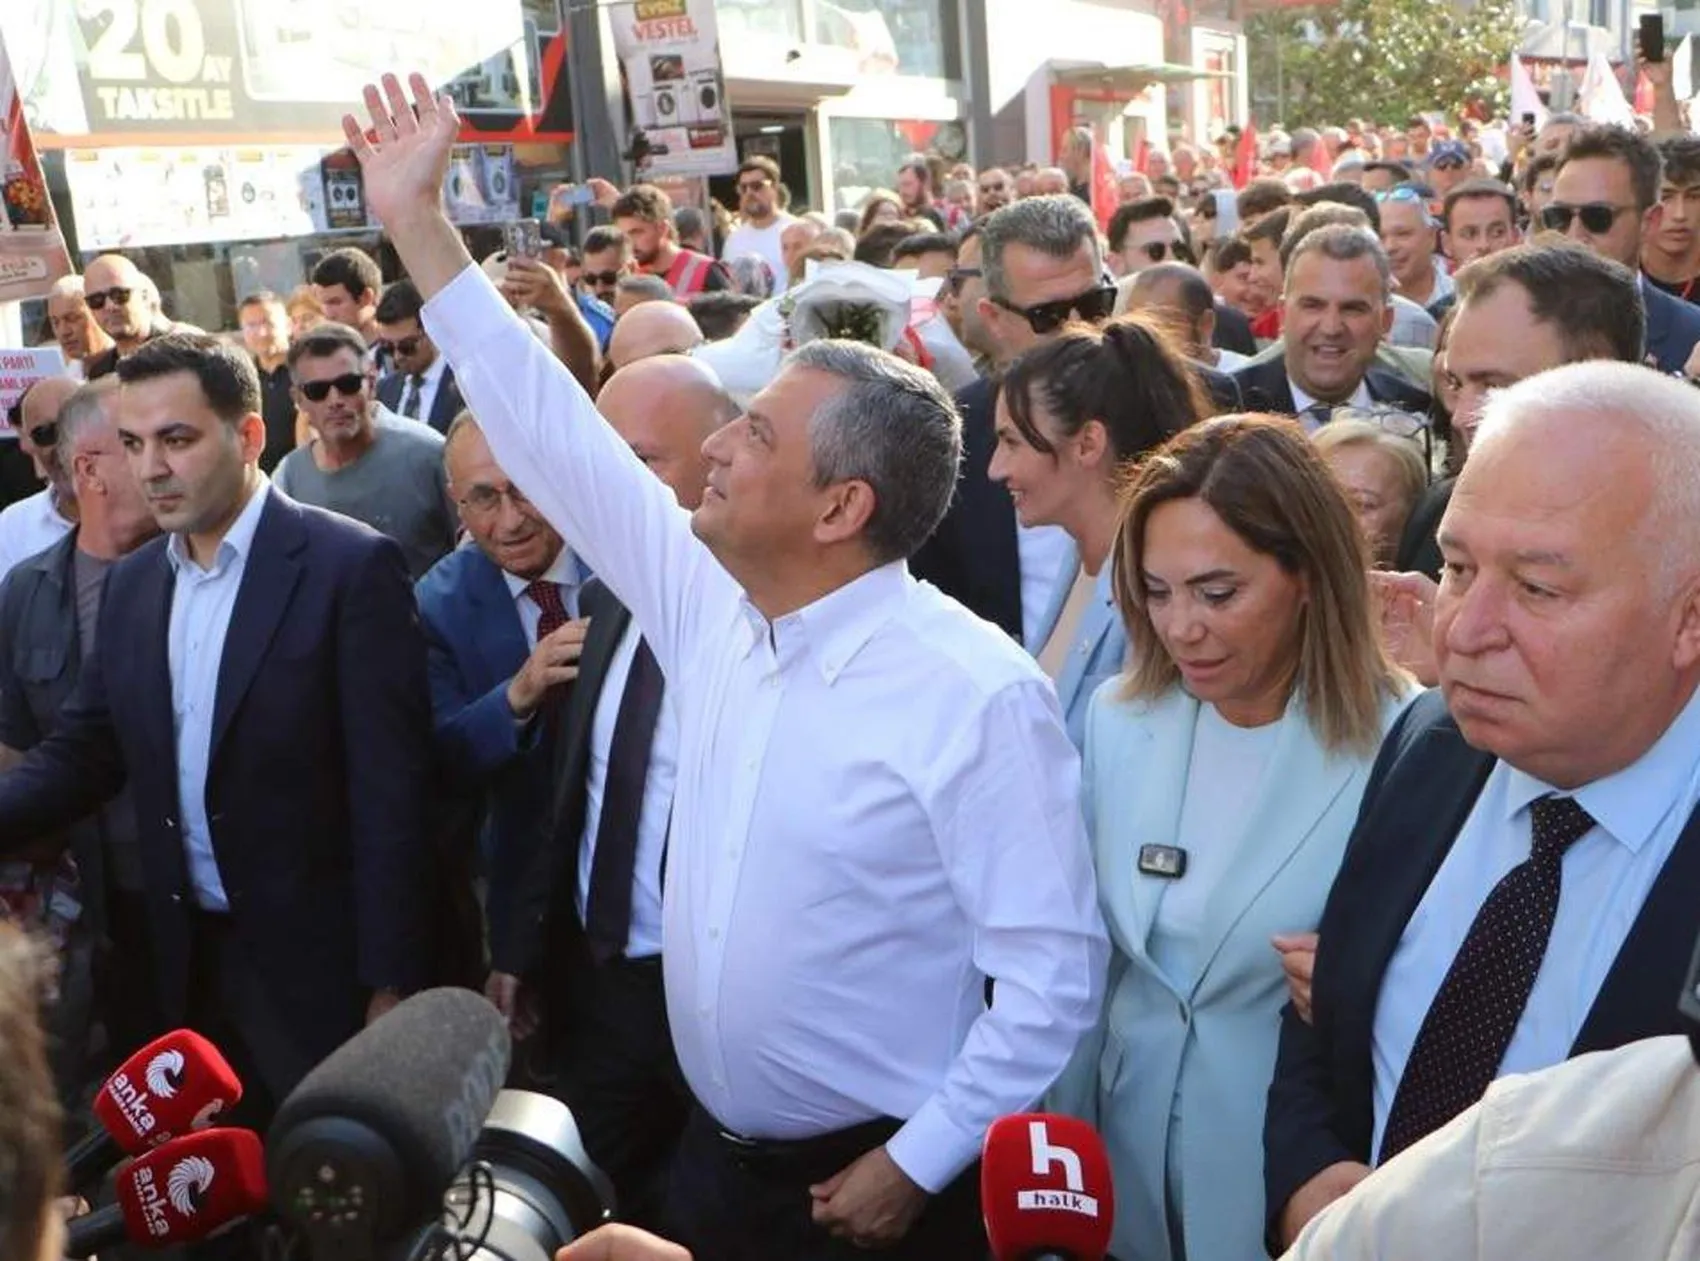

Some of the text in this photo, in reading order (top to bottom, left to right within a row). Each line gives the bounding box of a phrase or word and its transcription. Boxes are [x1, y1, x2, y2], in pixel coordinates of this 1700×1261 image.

[78, 0, 233, 83] 20 AY
[631, 16, 698, 41] VESTEL
[113, 1073, 155, 1131] anka
[138, 1167, 170, 1236] anka
[1034, 1191, 1083, 1210] halk
